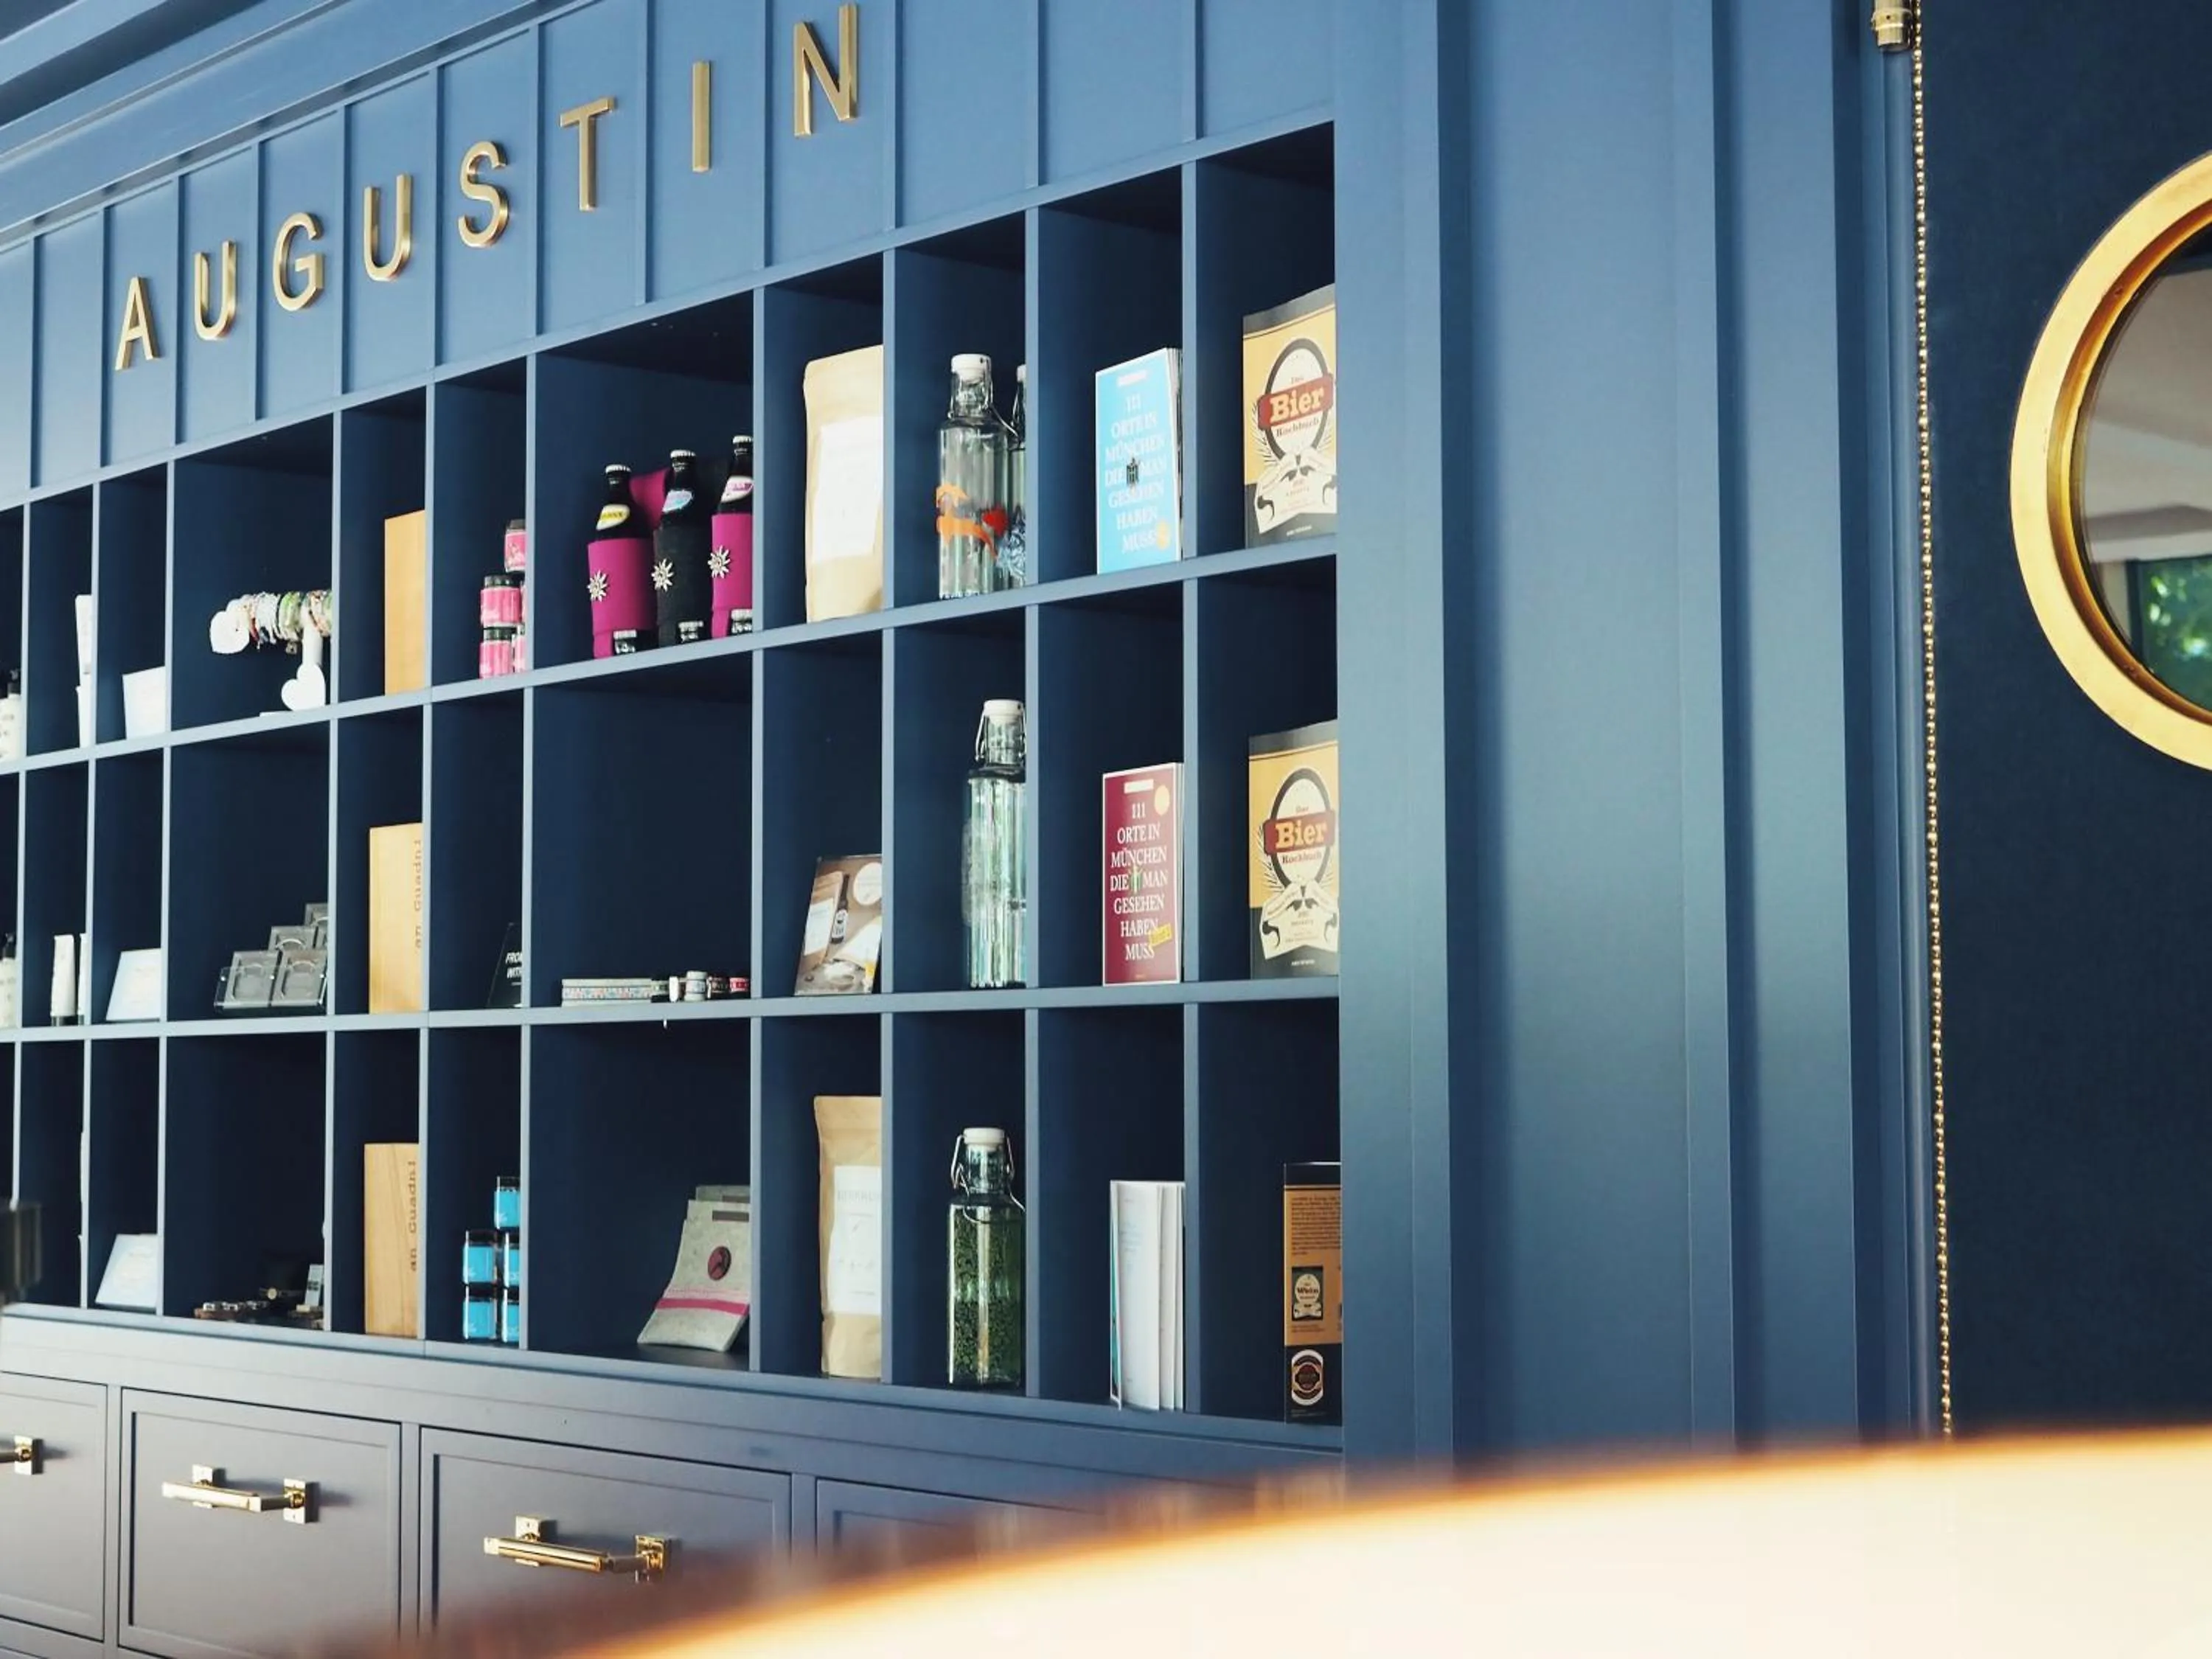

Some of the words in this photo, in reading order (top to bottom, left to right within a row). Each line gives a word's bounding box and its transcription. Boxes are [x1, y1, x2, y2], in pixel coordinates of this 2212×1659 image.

[114, 2, 860, 371] AUGUSTIN
[1270, 386, 1325, 423] Bier
[1132, 801, 1146, 819] 111
[1116, 825, 1147, 844] ORTE
[1148, 821, 1161, 841] IN
[1275, 819, 1327, 849] Bier
[1110, 845, 1168, 869] MÜNCHEN
[1110, 874, 1129, 892] DIE
[1142, 869, 1169, 888] MAN
[1113, 893, 1165, 915] GESEHEN
[1120, 919, 1159, 938] HABEN
[1125, 943, 1155, 961] MUSS
